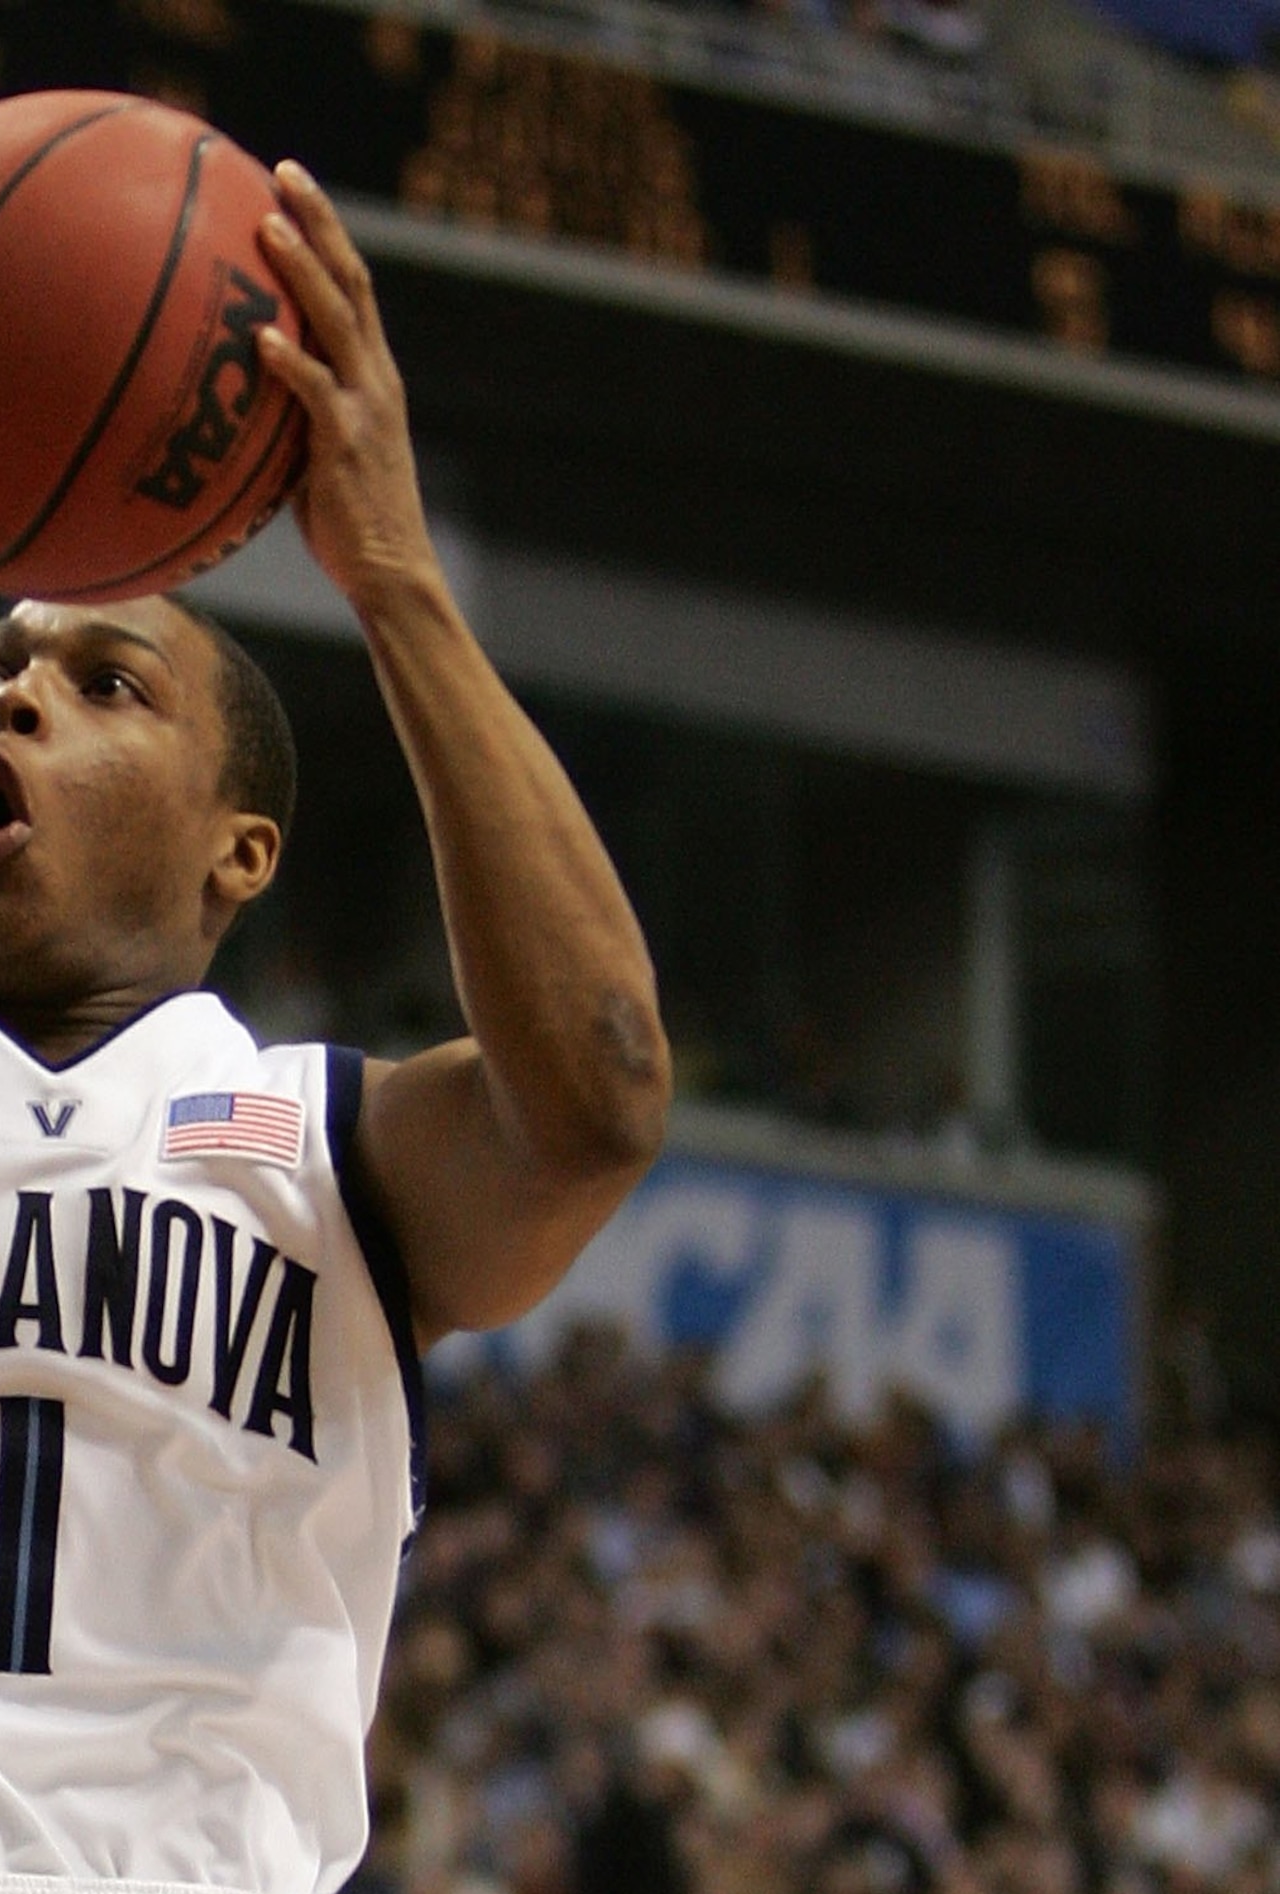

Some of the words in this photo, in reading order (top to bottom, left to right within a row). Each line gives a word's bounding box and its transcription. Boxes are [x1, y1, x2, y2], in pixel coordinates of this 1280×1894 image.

[135, 265, 279, 511] NCAA
[25, 1099, 82, 1138] V
[460, 1186, 1020, 1448] CAA
